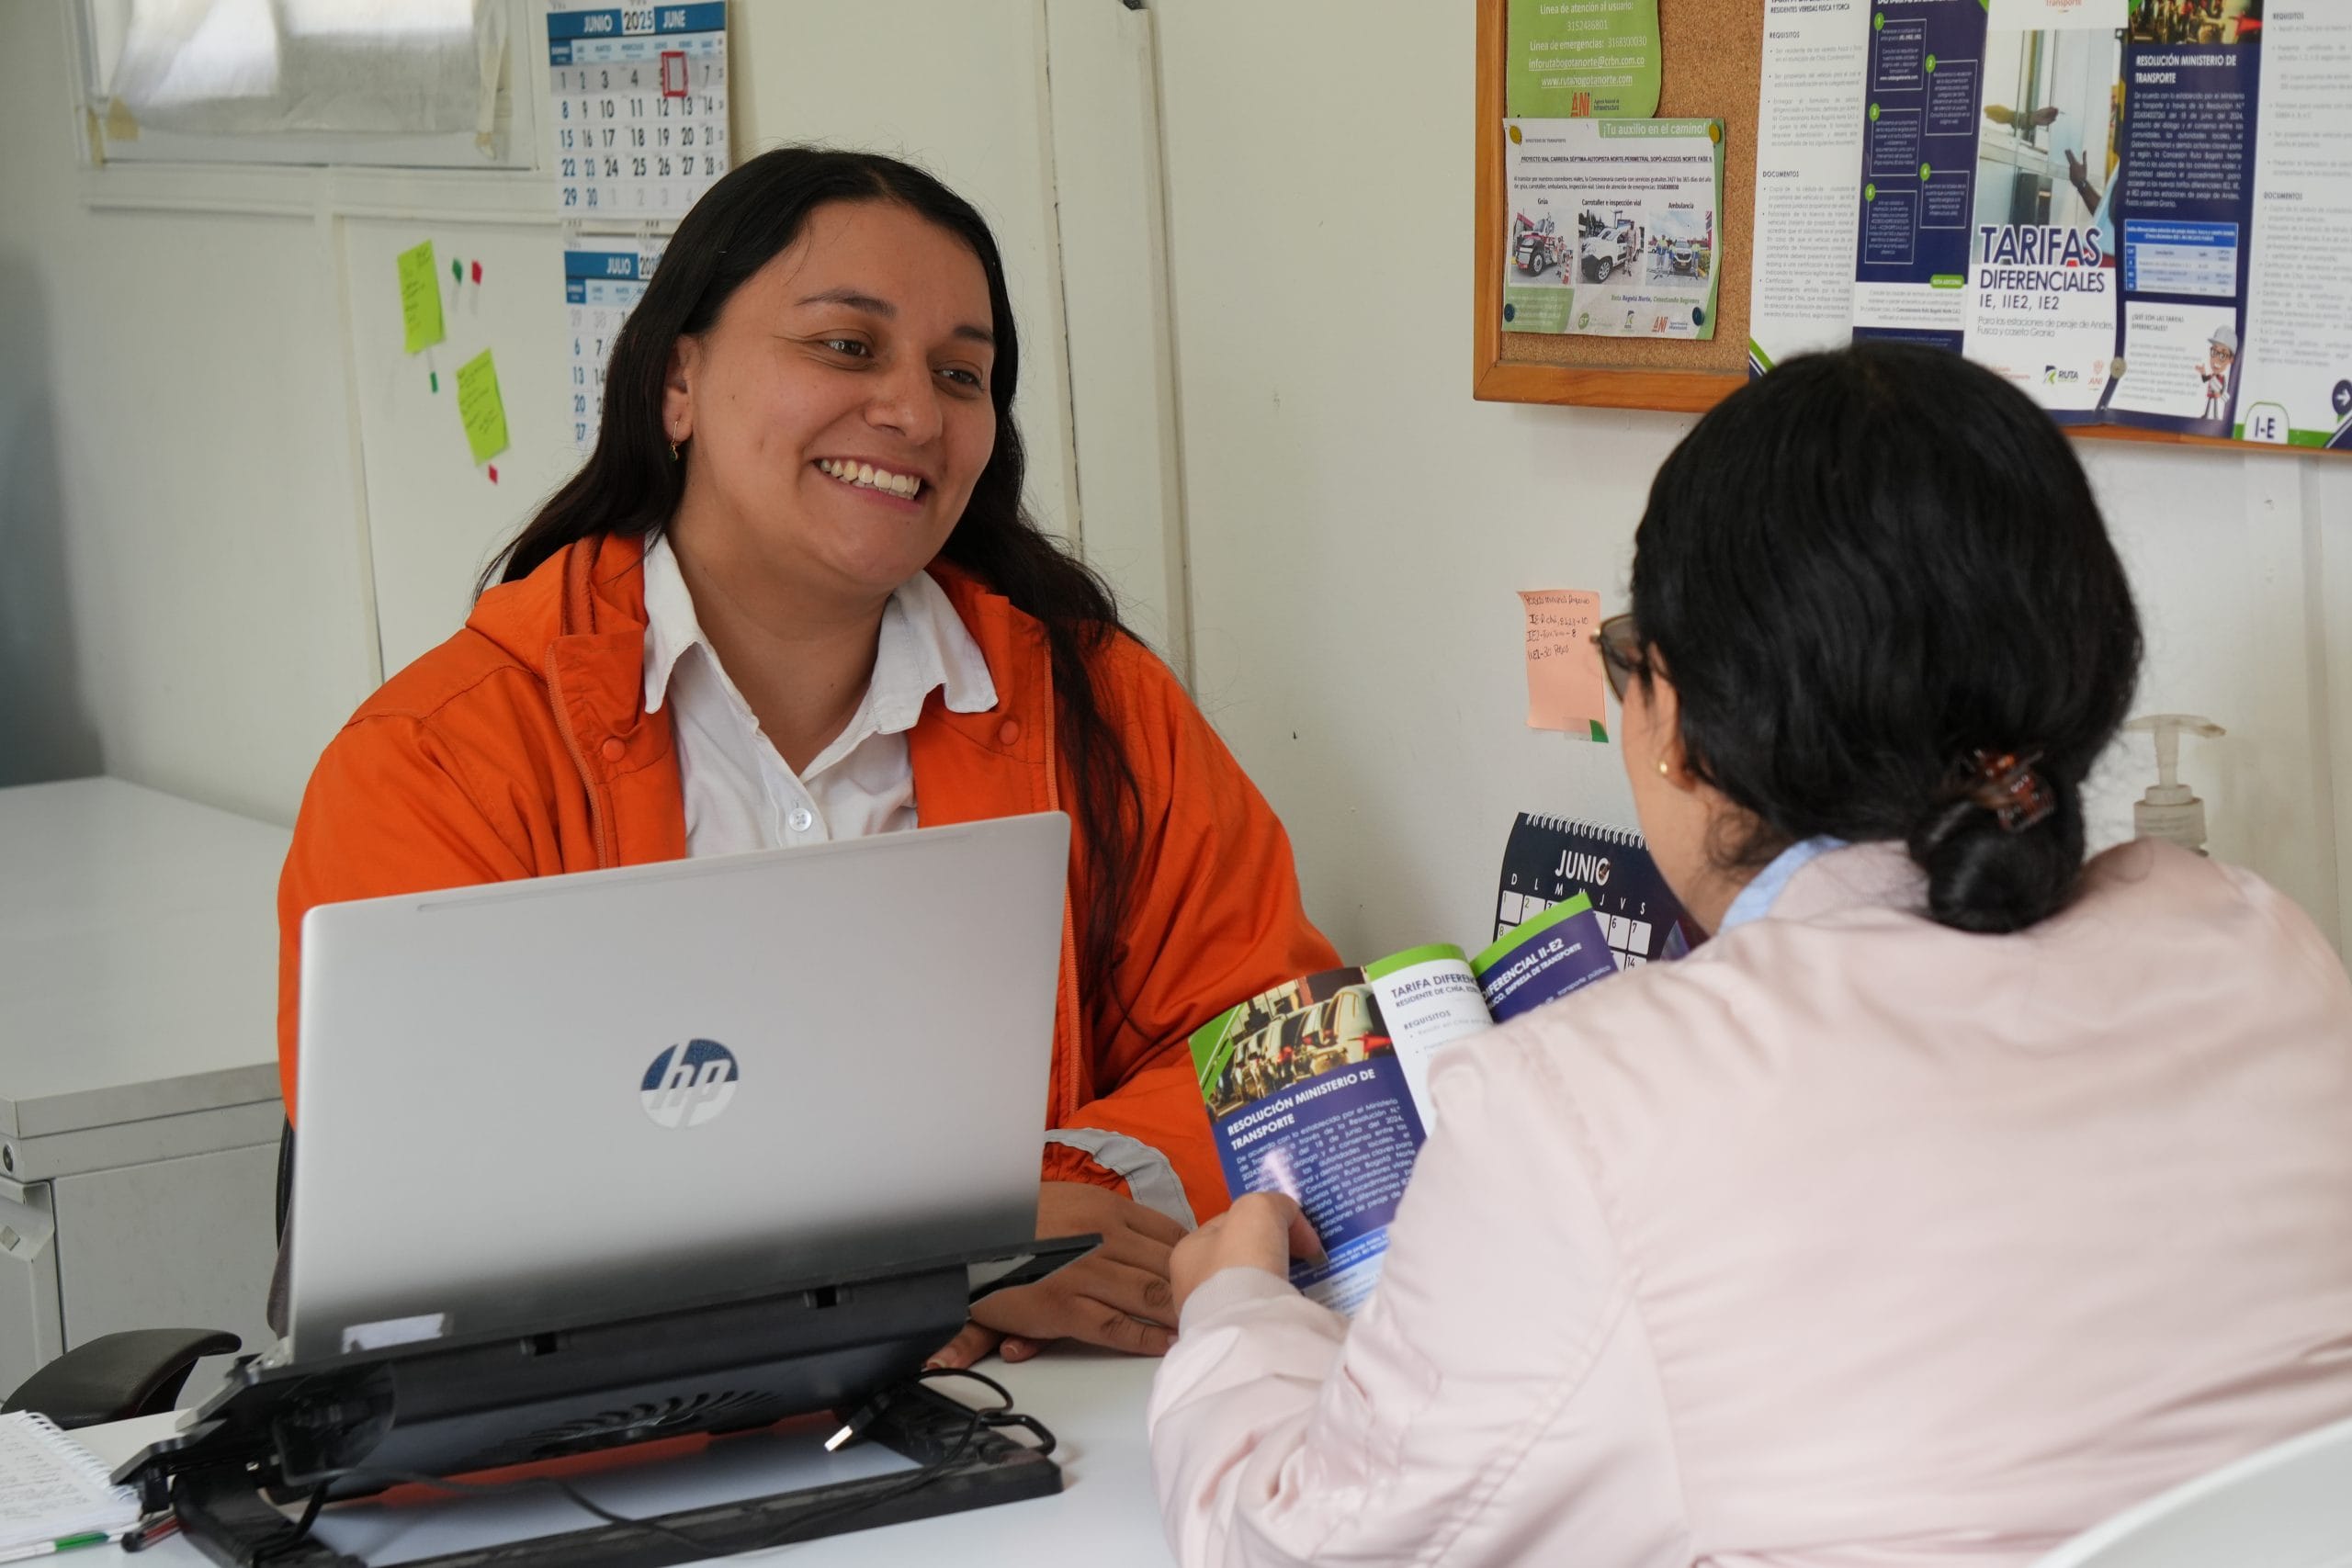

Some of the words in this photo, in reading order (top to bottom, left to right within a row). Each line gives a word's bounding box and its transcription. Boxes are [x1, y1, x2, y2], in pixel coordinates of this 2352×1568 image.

[1540, 4, 1559, 15] Línea
[1561, 4, 1569, 14] de
[1571, 2, 1600, 13] atención
[1600, 2, 1607, 12] al
[1608, 1, 1634, 11] usuario:
[2272, 12, 2304, 20] REQUISITOS
[583, 14, 613, 33] JUNIO
[624, 11, 653, 31] 2025
[662, 9, 686, 28] JUNE
[1530, 40, 1549, 51] Línea
[1550, 40, 1559, 51] de
[1560, 39, 1604, 51] emergencias:
[2135, 53, 2180, 66] RESOLUCIÓN
[2181, 55, 2224, 66] MINISTERIO
[2225, 55, 2237, 66] DE
[560, 72, 566, 89] 1
[580, 72, 586, 90] 2
[601, 71, 609, 89] 3
[630, 69, 639, 87] 4
[2135, 72, 2177, 84] TRANSPORTE
[561, 100, 569, 119] 8
[582, 100, 588, 119] 9
[600, 99, 615, 118] 10
[630, 98, 643, 118] 11
[656, 97, 669, 117] 12
[681, 96, 693, 116] 13
[704, 96, 713, 115] 14
[560, 129, 574, 148] 15
[582, 129, 593, 148] 16
[603, 129, 616, 147] 17
[631, 128, 645, 147] 18
[658, 128, 670, 146] 19
[681, 127, 695, 146] 20
[705, 127, 714, 145] 21
[1618, 124, 1647, 135] auxilio
[1648, 125, 1659, 135] en
[1661, 124, 1668, 134] el
[1670, 123, 1706, 135] camino!
[561, 159, 576, 177] 22
[584, 158, 595, 177] 23
[605, 158, 618, 177] 24
[632, 158, 647, 176] 25
[658, 157, 671, 176] 26
[682, 156, 695, 175] 27
[705, 157, 714, 175] 28
[563, 187, 577, 207] 29
[586, 187, 597, 207] 30
[1980, 226, 2102, 267] TARIFAS
[606, 257, 631, 276] JULIO
[1980, 268, 2105, 293] DIFERENCIALES
[2039, 296, 2060, 310] IE2
[1977, 325, 1997, 335] Fusca
[2005, 327, 2029, 336] caseta
[1978, 316, 1995, 325] Para
[1996, 316, 2006, 325] las
[2007, 317, 2043, 327] estaciones
[2045, 319, 2056, 327] de
[2057, 320, 2077, 330] peaje
[2079, 320, 2089, 329] de
[574, 337, 581, 355] 6
[596, 339, 602, 356] 7
[572, 367, 584, 385] 13
[594, 368, 605, 386] 14
[2058, 370, 2078, 379] RUTA
[574, 395, 585, 413] 20
[575, 423, 586, 441] 27
[1555, 849, 1610, 886] JUNIO
[1510, 873, 1518, 886] D
[1534, 878, 1539, 891] L
[1555, 883, 1564, 897] M
[1600, 894, 1605, 907] J
[1620, 897, 1626, 910] V
[1640, 902, 1645, 915] S
[1524, 897, 1530, 908] 2
[1611, 918, 1617, 929] 6
[1632, 922, 1637, 934] 7
[1498, 926, 1504, 936] 8
[1537, 937, 1565, 958] II-E2
[1505, 972, 1531, 995] EMPRESA
[1531, 966, 1541, 976] DE
[1540, 942, 1581, 969] TRANSPORTE
[1626, 955, 1635, 967] 14
[1391, 978, 1430, 998] TARIFA
[1396, 990, 1432, 1007] RESIDENTE
[1404, 1010, 1451, 1029] REQUISITOS
[645, 1038, 735, 1129] hp
[1227, 1096, 1294, 1135] RESOLUCIÓN
[1294, 1073, 1358, 1104] MINISTERIO
[1359, 1068, 1375, 1080] DE
[1230, 1113, 1295, 1150] TRANSPORTE
[1248, 1141, 1275, 1157] acuerdo
[1277, 1135, 1290, 1144] con
[1300, 1114, 1340, 1134] establecido
[1342, 1110, 1354, 1119] por
[1365, 1098, 1397, 1110] Ministerio
[1299, 1133, 1319, 1144] través
[1349, 1109, 1385, 1124] Resolución
[1345, 1126, 1363, 1137] junio
[1367, 1120, 1379, 1128] del
[1343, 1153, 1370, 1167] actores
[1371, 1145, 1394, 1156] claves
[1395, 1140, 1412, 1149] para
[1343, 1166, 1360, 1176] Ruta
[1364, 1155, 1391, 1168] Bogotá
[1396, 1149, 1415, 1157] Norte
[1392, 1158, 1412, 1168] viales
[1319, 1211, 1352, 1228] estaciones
